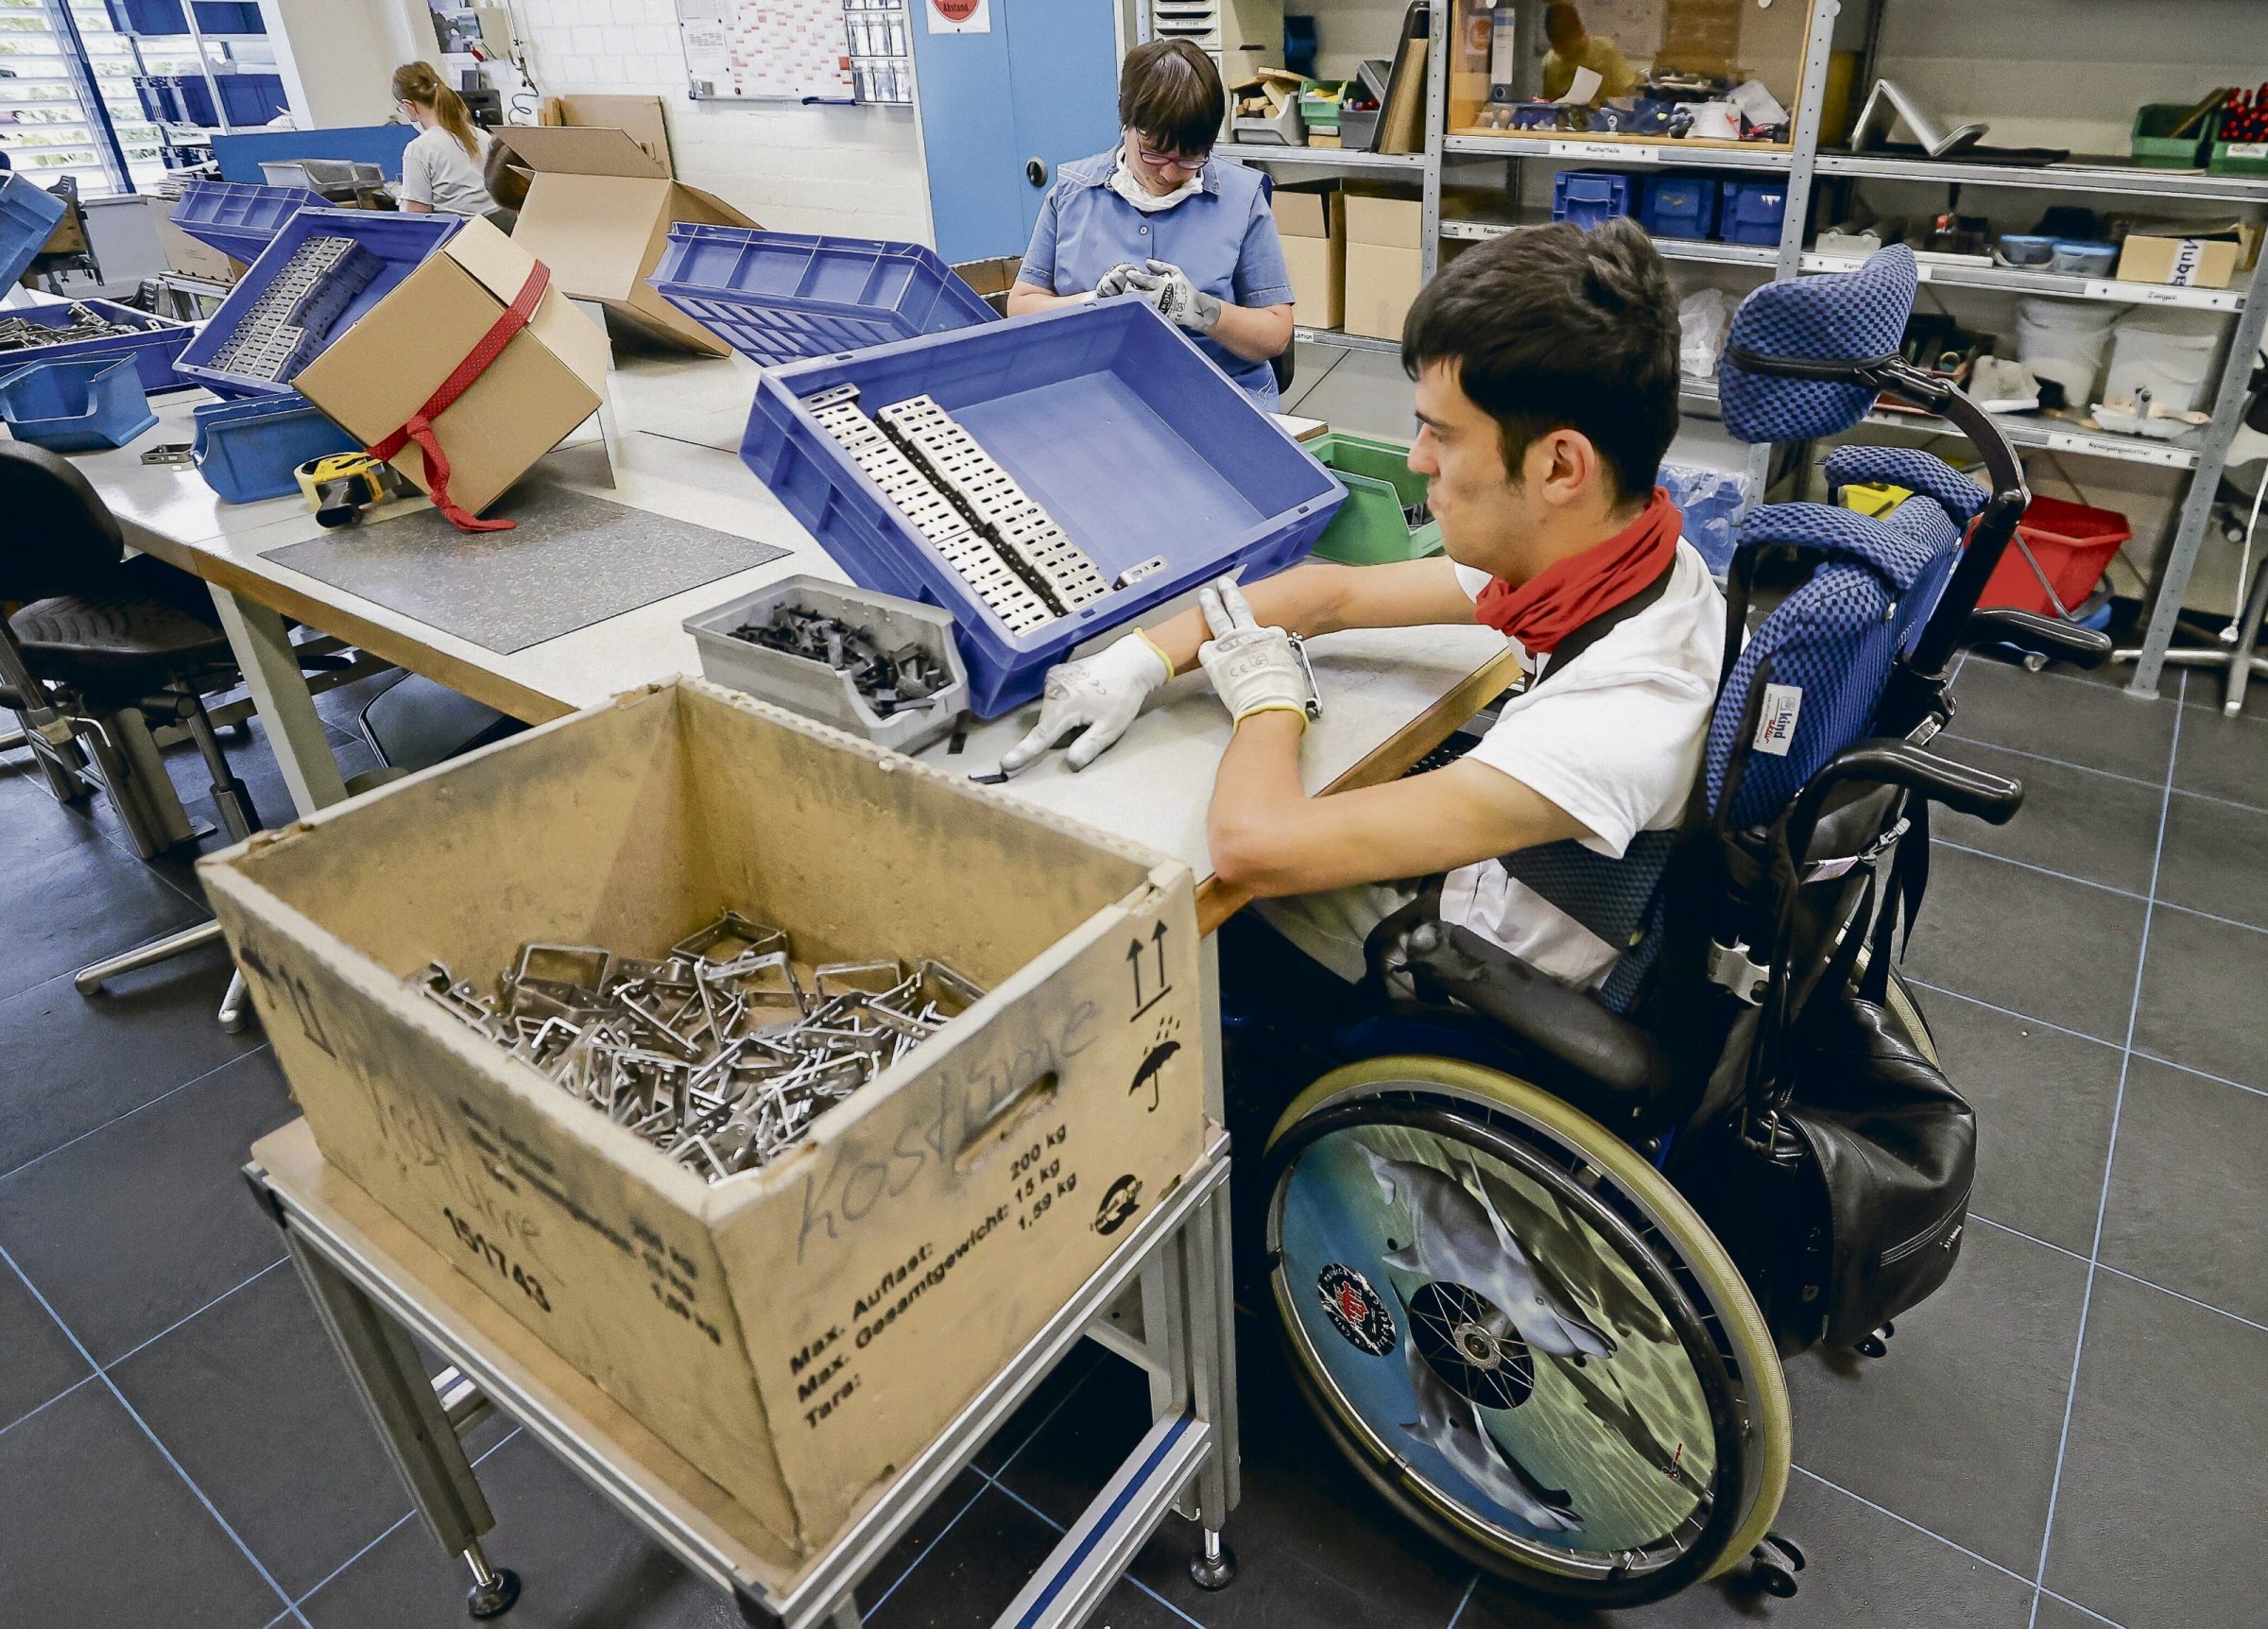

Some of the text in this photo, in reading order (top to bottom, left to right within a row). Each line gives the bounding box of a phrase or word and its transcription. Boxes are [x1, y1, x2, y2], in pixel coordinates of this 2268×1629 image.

[1774, 712, 1793, 739] kind
[790, 1124, 1067, 1376] Max. Auflast: 200 kg
[798, 1158, 1060, 1403] Max. Gesamtgewicht: 15 kg
[804, 1373, 861, 1429] Tara:
[1057, 1173, 1077, 1197] kg
